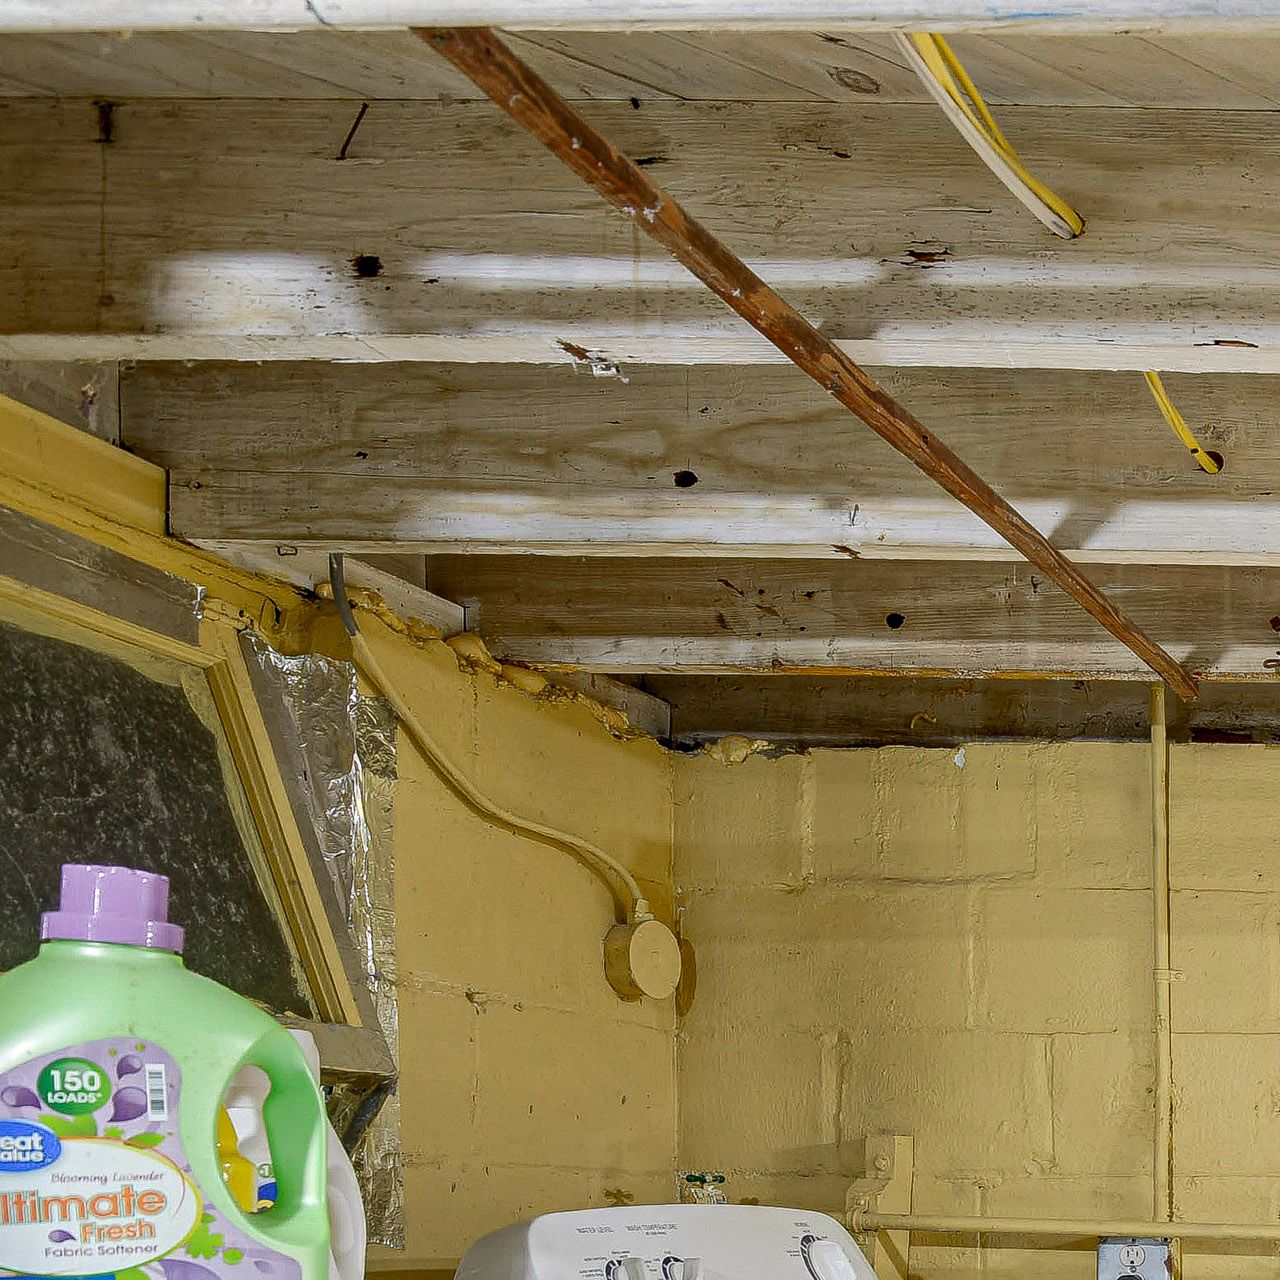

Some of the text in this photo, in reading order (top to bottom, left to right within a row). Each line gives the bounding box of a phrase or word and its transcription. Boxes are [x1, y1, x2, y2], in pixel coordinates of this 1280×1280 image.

[50, 1070, 101, 1092] 150
[80, 1218, 156, 1244] Fresh
[45, 1244, 157, 1259] Fabric Softener
